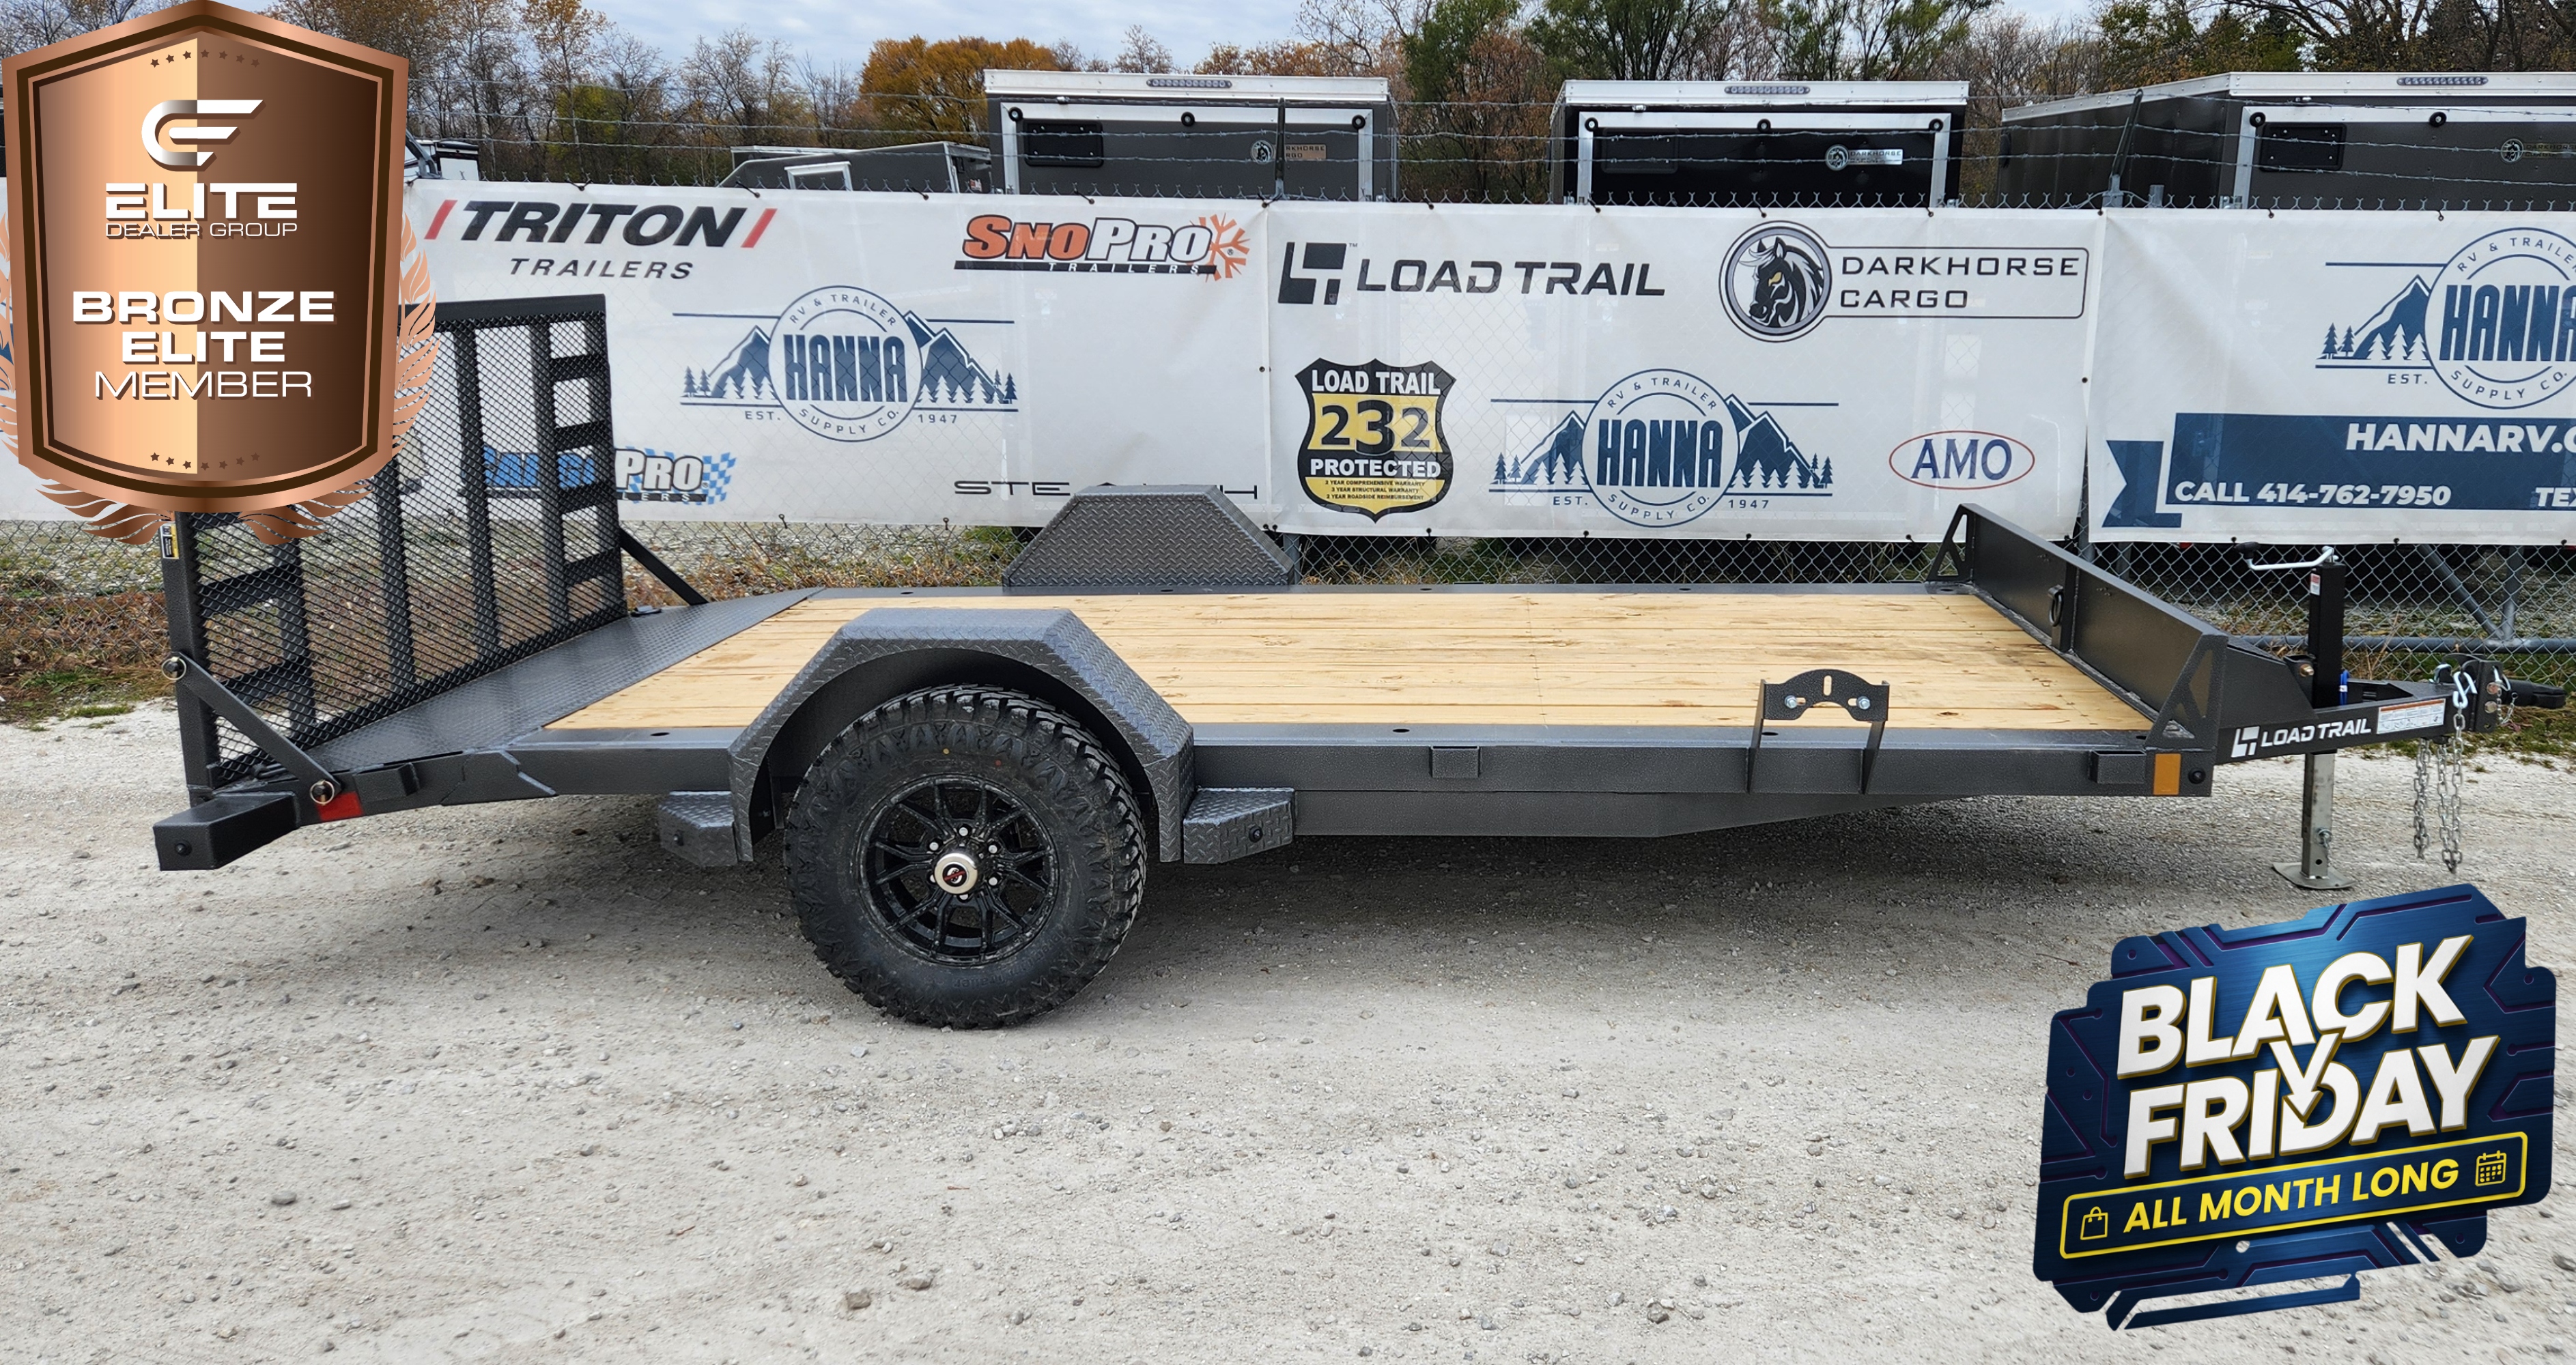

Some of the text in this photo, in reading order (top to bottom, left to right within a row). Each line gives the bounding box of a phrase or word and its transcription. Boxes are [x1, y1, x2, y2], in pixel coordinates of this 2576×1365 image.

[460, 201, 748, 247] TRITON
[510, 257, 694, 280] TRAILERS
[1048, 262, 1200, 274] TRAILERS
[1842, 257, 2080, 276] DARKHORSE
[2457, 252, 2477, 272] RV
[2489, 242, 2498, 252] &
[1357, 259, 1502, 293] LOAD
[1514, 261, 1665, 296] TRAIL
[789, 293, 896, 326] RV & TRAILER
[1840, 289, 1968, 308] CARGO
[2439, 284, 2576, 362] HANNA
[783, 334, 907, 402] HANNA
[1311, 369, 1441, 395] LOAD TRAIL
[2388, 374, 2429, 385] EST.
[1607, 377, 1717, 410] RV & TRAILER
[2450, 370, 2568, 400] SUPPLY CO.
[745, 410, 957, 425] EST. 1947
[799, 408, 899, 435] SUPPLY CO.
[1320, 399, 1430, 457] 232
[1596, 419, 1723, 488] HANNA
[1911, 437, 2013, 480] AMO
[1310, 458, 1441, 478] PROTECTED
[1553, 496, 1770, 509] EST. 1947
[1608, 493, 1710, 520] SUPPLY CO.
[2175, 480, 2451, 506] CALL 414-762-7950
[2261, 725, 2315, 747] LOAD
[2318, 718, 2372, 739] TRAIL
